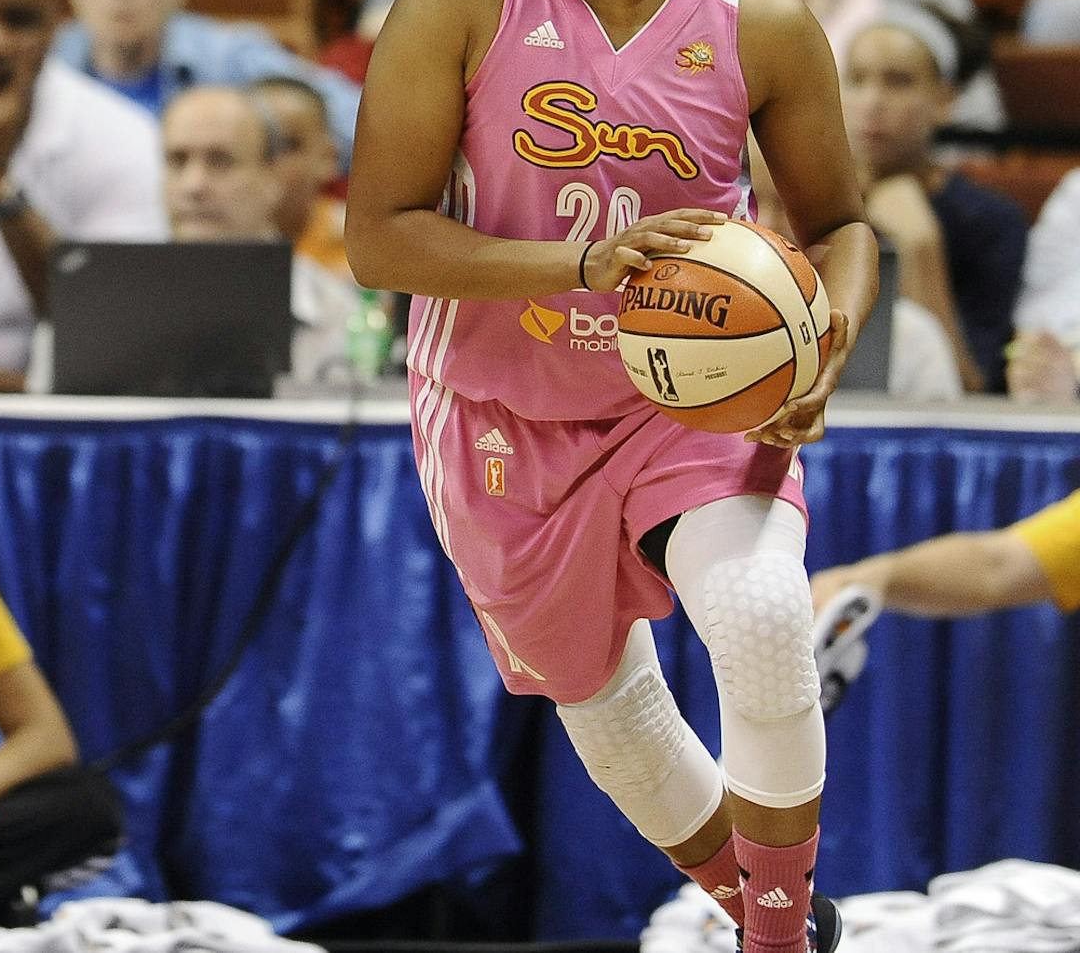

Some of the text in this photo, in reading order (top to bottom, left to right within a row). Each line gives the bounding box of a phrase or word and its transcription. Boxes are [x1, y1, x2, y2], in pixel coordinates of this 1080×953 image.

[523, 35, 565, 50] adidas
[513, 79, 699, 180] Sun
[569, 307, 619, 337] bo
[569, 337, 618, 352] mobil
[474, 441, 514, 455] adidas
[757, 896, 793, 908] adidas
